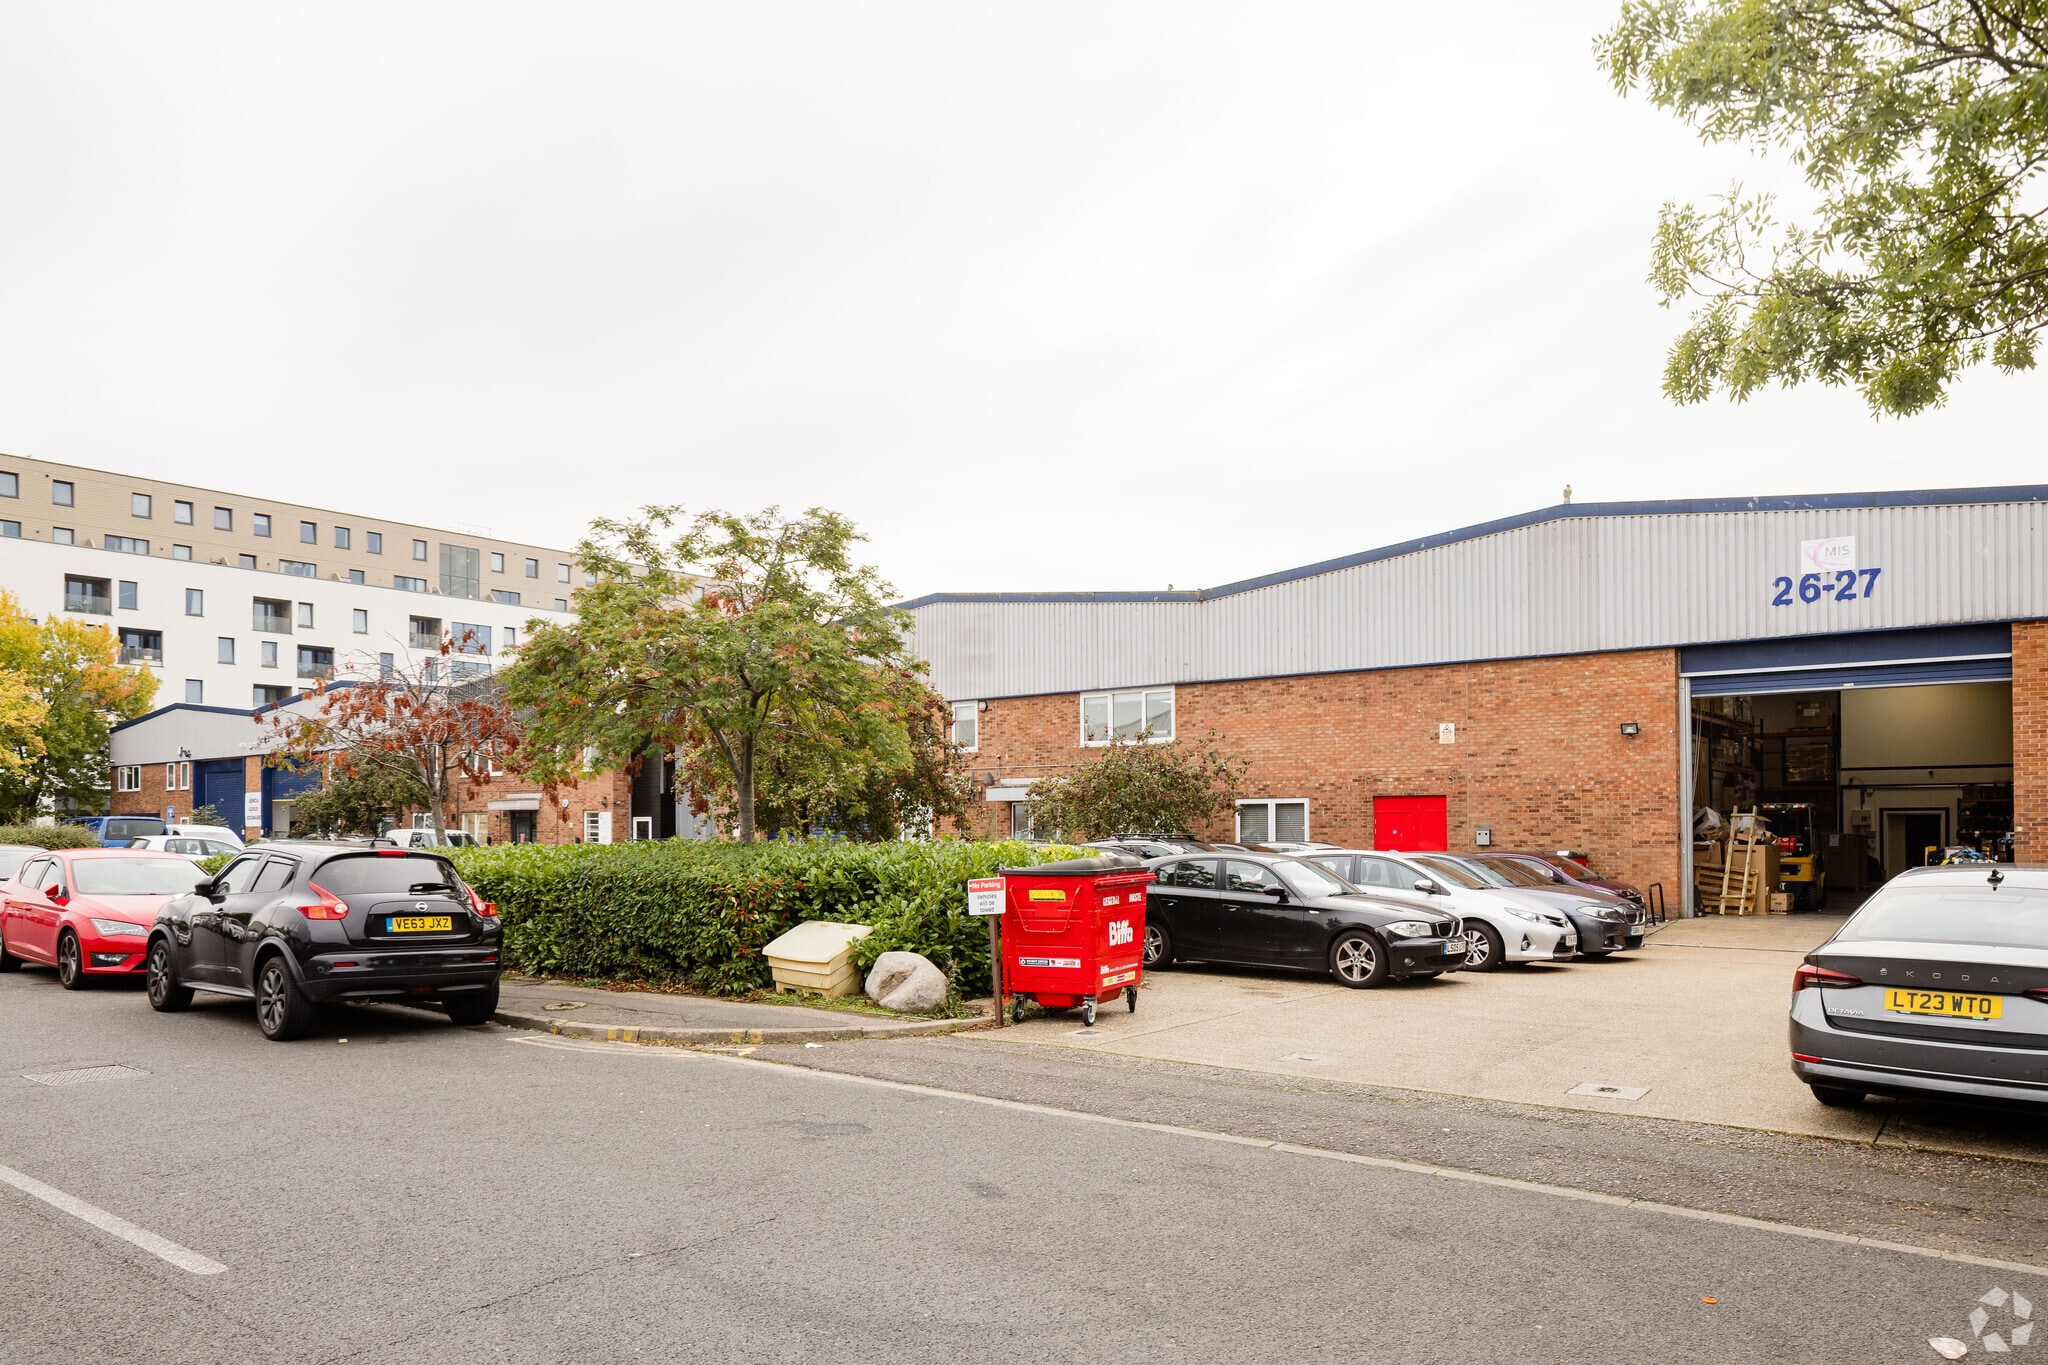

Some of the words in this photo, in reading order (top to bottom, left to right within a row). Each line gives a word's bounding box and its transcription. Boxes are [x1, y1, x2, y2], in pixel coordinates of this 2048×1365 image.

[1825, 545, 1850, 557] MIS
[1772, 568, 1881, 606] 26-27
[395, 918, 425, 929] VE63
[429, 917, 449, 929] JXZ
[1109, 919, 1133, 947] Biffa
[1827, 1007, 1865, 1016] OCTAVIA
[1893, 991, 1945, 1011] LT23
[1951, 995, 1992, 1015] WTO
